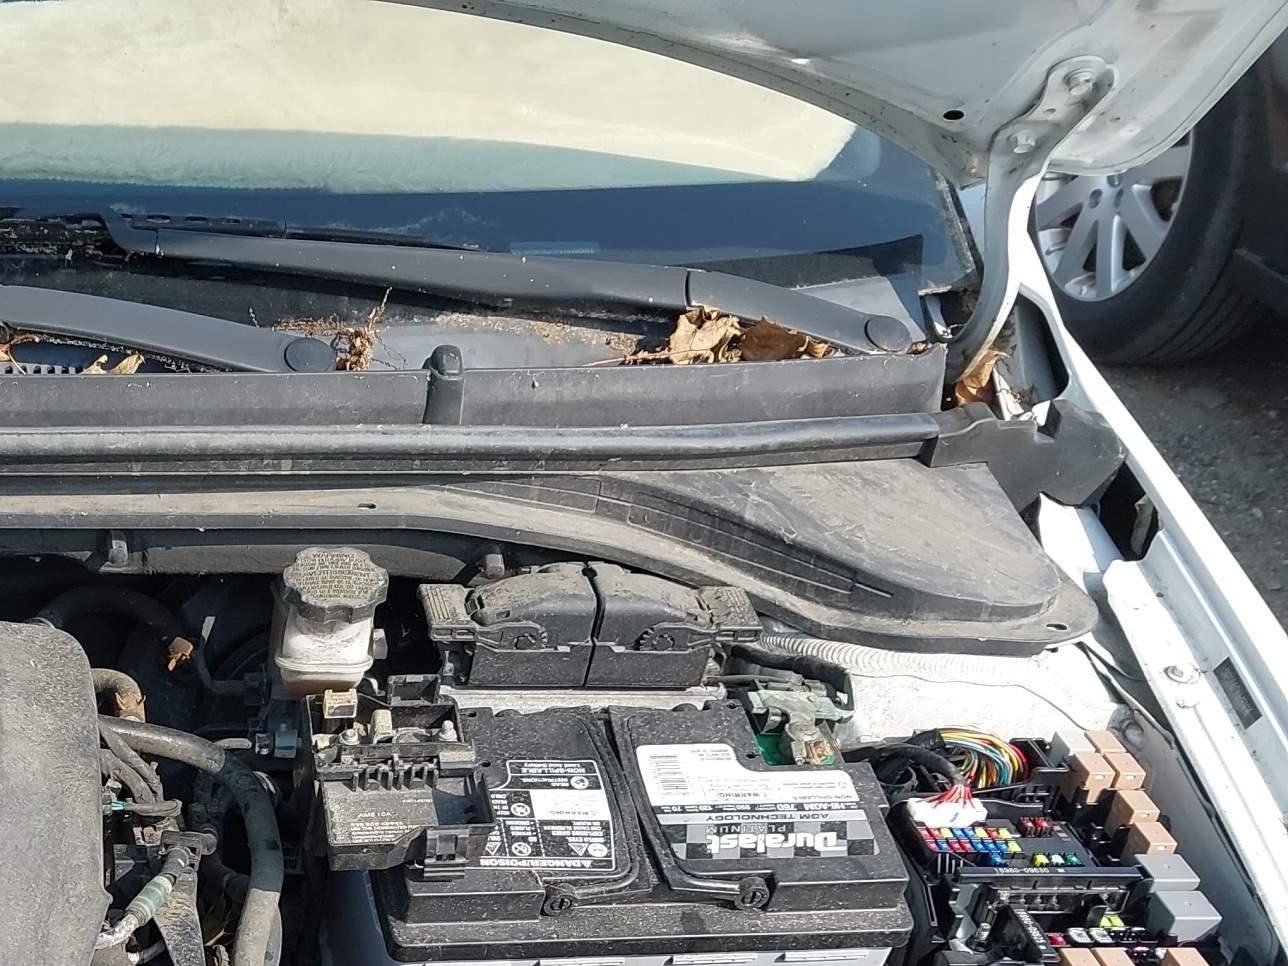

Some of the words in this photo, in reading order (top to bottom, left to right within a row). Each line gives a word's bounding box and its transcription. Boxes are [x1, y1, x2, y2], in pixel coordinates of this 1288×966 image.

[705, 813, 796, 822] TECHNOLOGY
[799, 813, 829, 821] AGM
[705, 824, 786, 833] PLATINUM
[706, 831, 847, 855] Duralast
